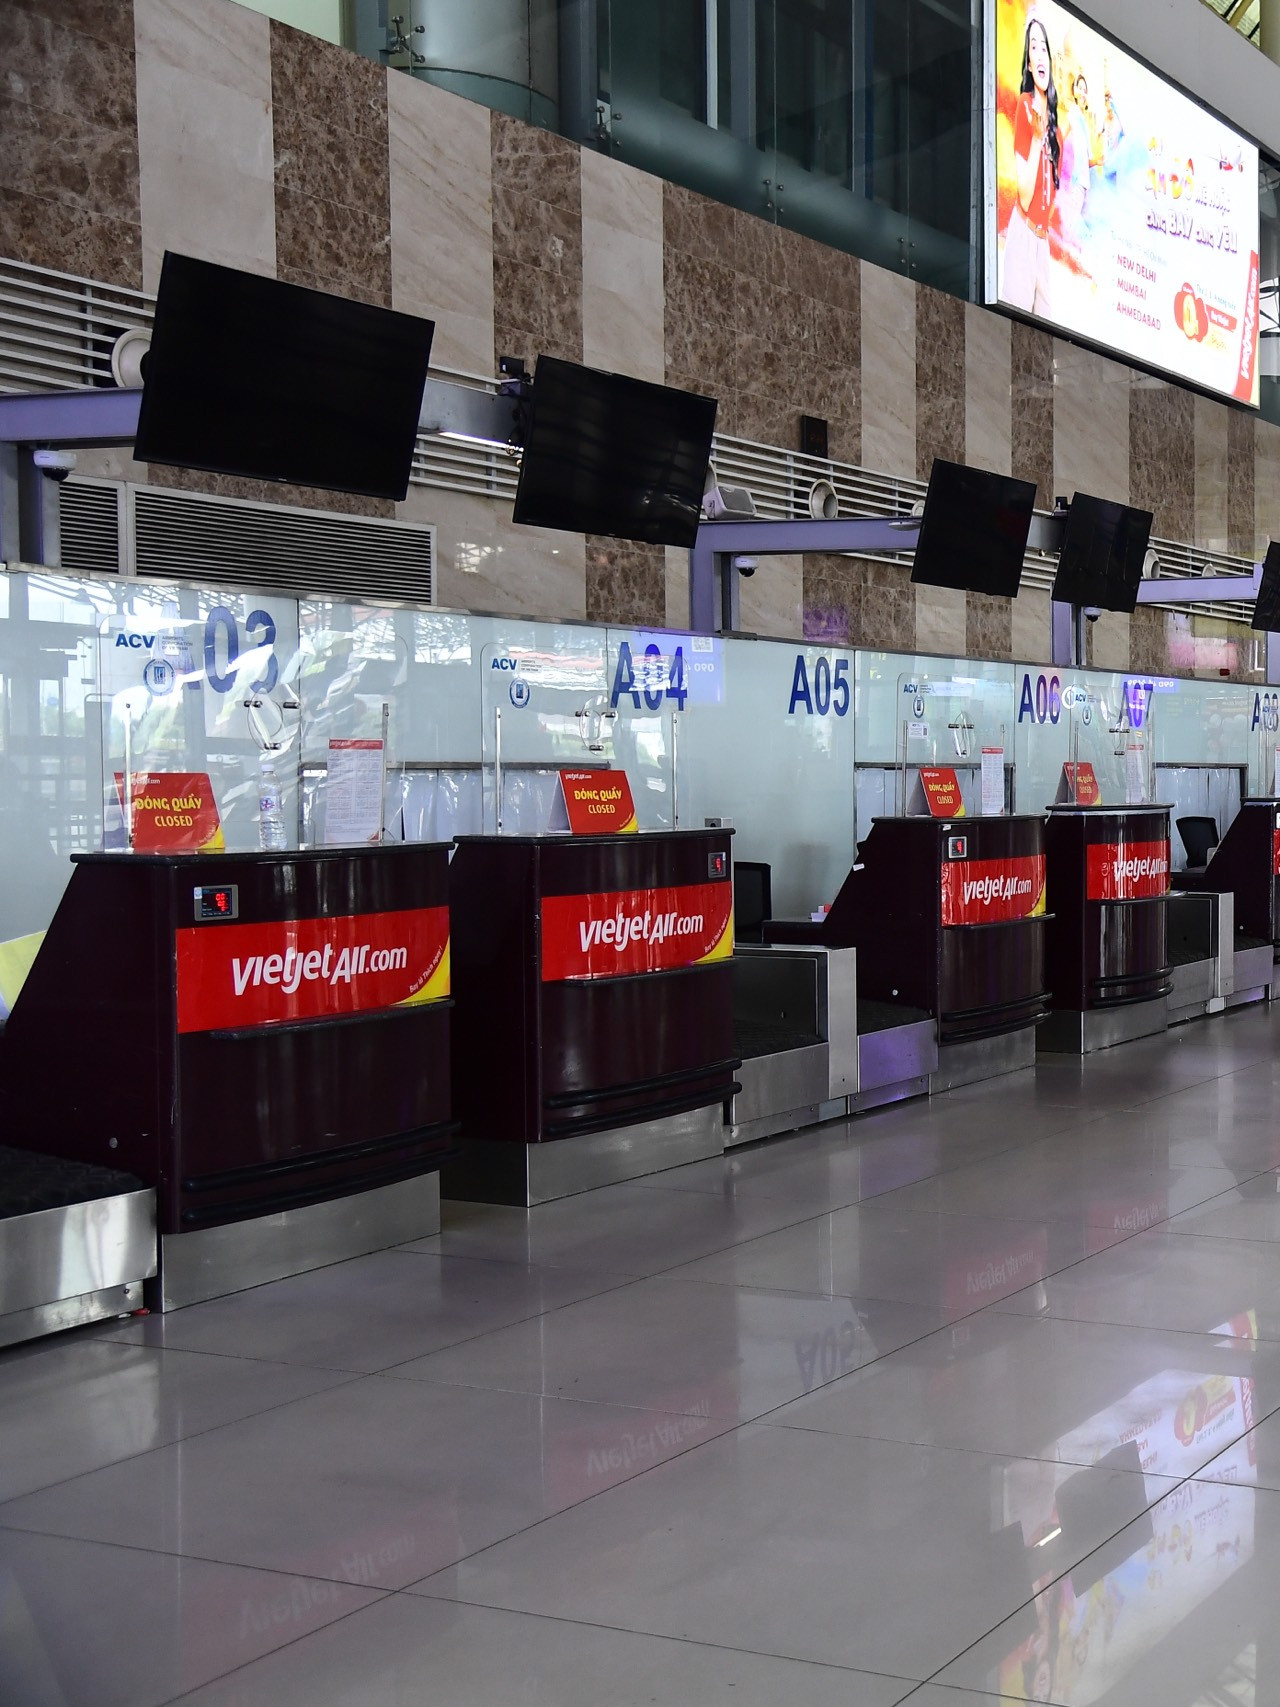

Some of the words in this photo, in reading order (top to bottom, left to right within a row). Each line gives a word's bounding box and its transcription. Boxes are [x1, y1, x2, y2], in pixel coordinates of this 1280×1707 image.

[1117, 254, 1135, 271] NEW
[1136, 263, 1157, 283] DELHI
[1117, 278, 1147, 300] MUMBAI
[1116, 302, 1161, 331] AHMEDABAD
[115, 633, 156, 648] ACV
[491, 657, 517, 670] ACV
[610, 641, 688, 711] A04
[788, 654, 850, 717] A05
[903, 684, 918, 693] ACV
[1075, 693, 1086, 703] ACV
[574, 788, 600, 801] ĐÓNG
[936, 796, 953, 804] CLOSED
[588, 804, 616, 814] CLOSED
[154, 815, 193, 827] CLOSED
